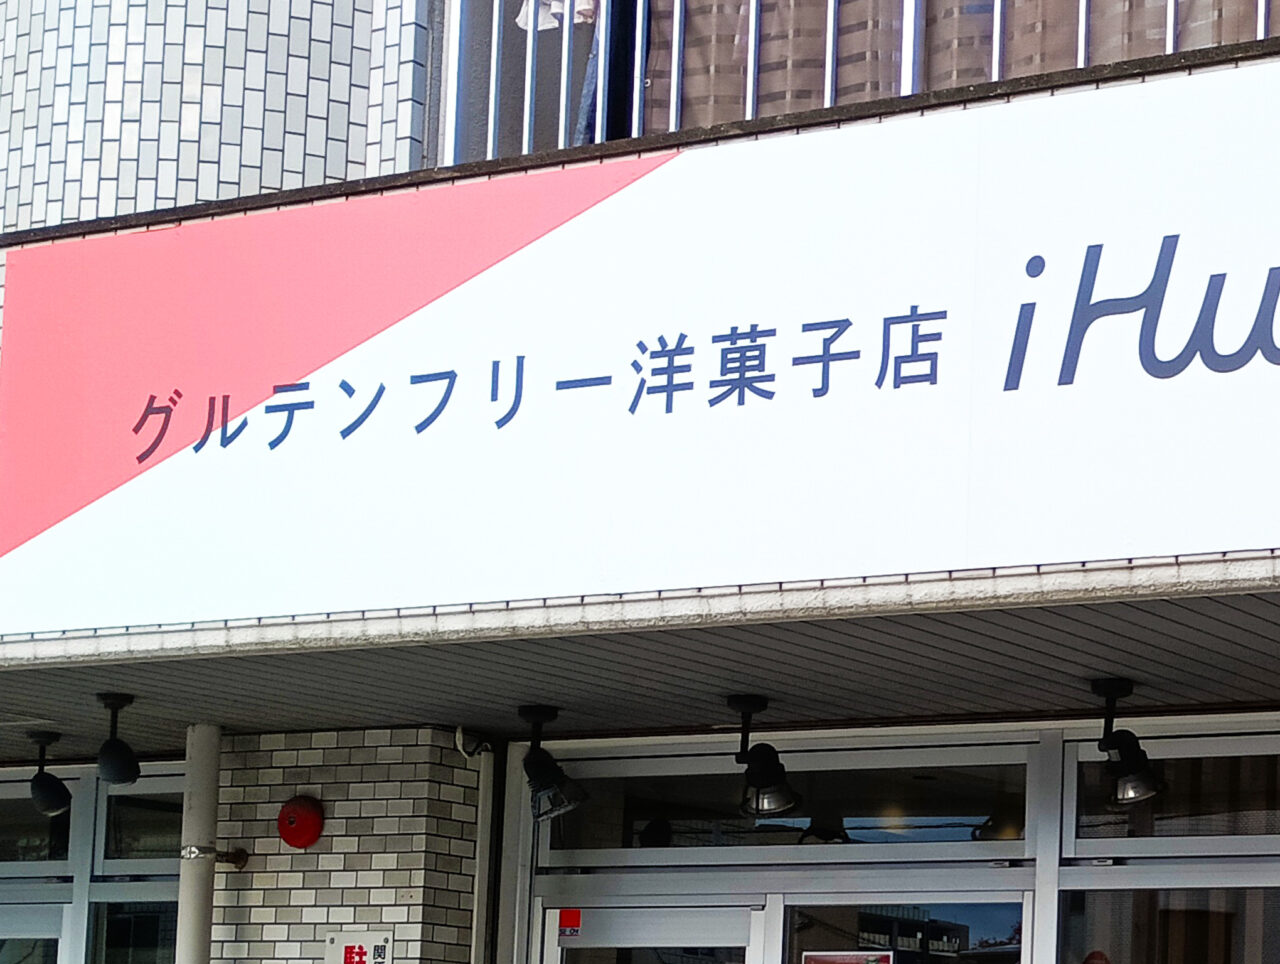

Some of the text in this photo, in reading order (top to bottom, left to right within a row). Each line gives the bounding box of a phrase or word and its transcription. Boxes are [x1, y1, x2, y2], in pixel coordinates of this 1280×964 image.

[131, 305, 949, 464] グルテンフリー洋菓子店
